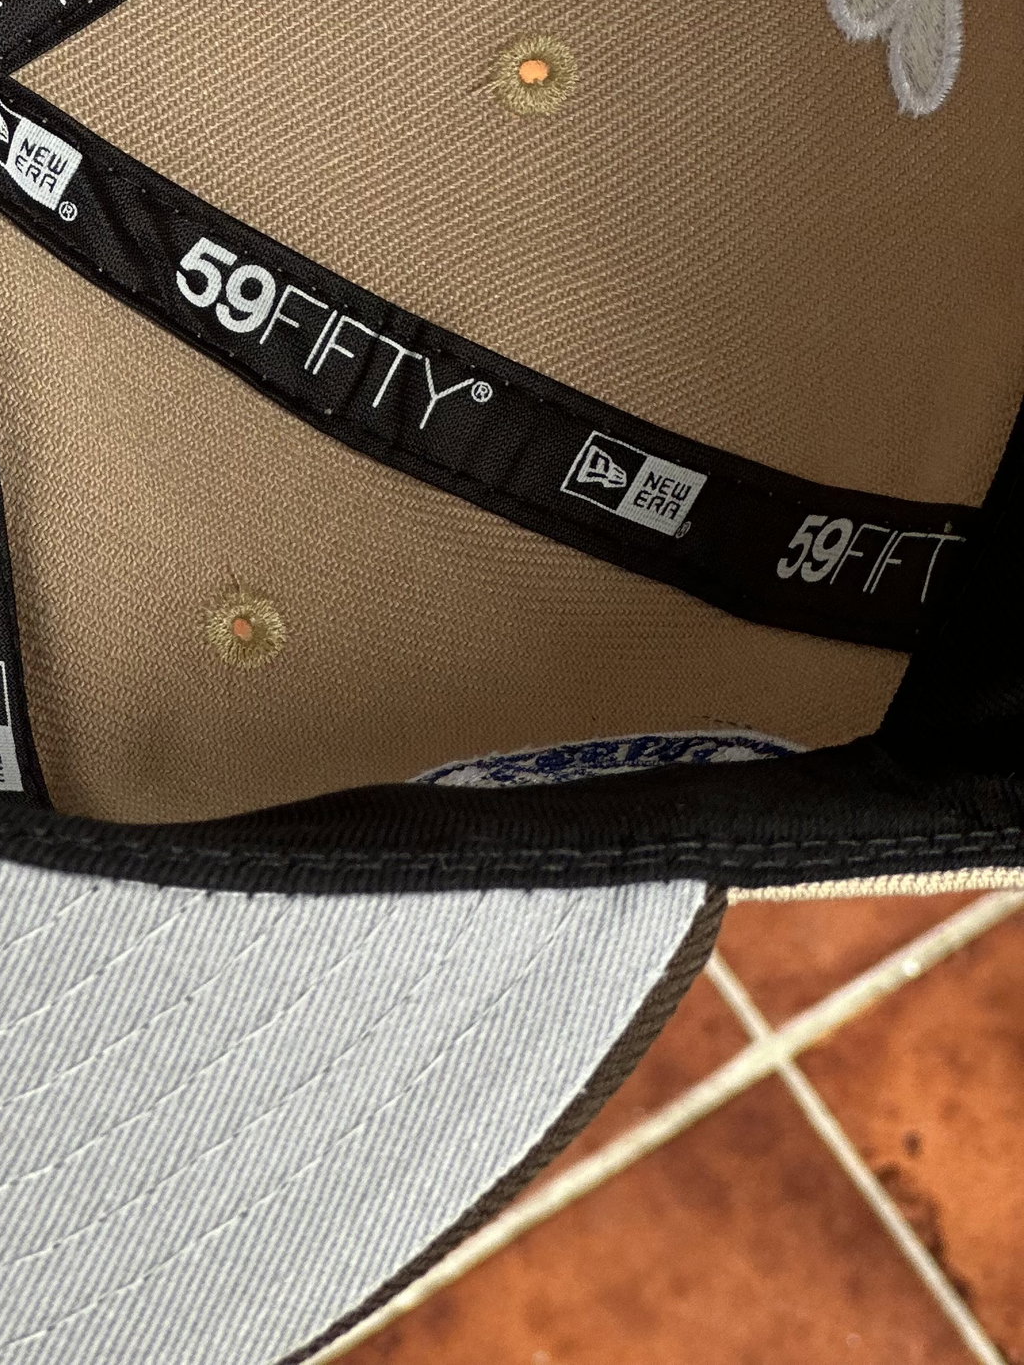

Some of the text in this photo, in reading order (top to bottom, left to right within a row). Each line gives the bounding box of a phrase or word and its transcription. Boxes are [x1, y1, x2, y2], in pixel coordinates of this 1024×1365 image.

[15, 155, 57, 193] ERA
[20, 138, 68, 176] NEW
[643, 471, 692, 501] NEW
[634, 490, 681, 520] ERA
